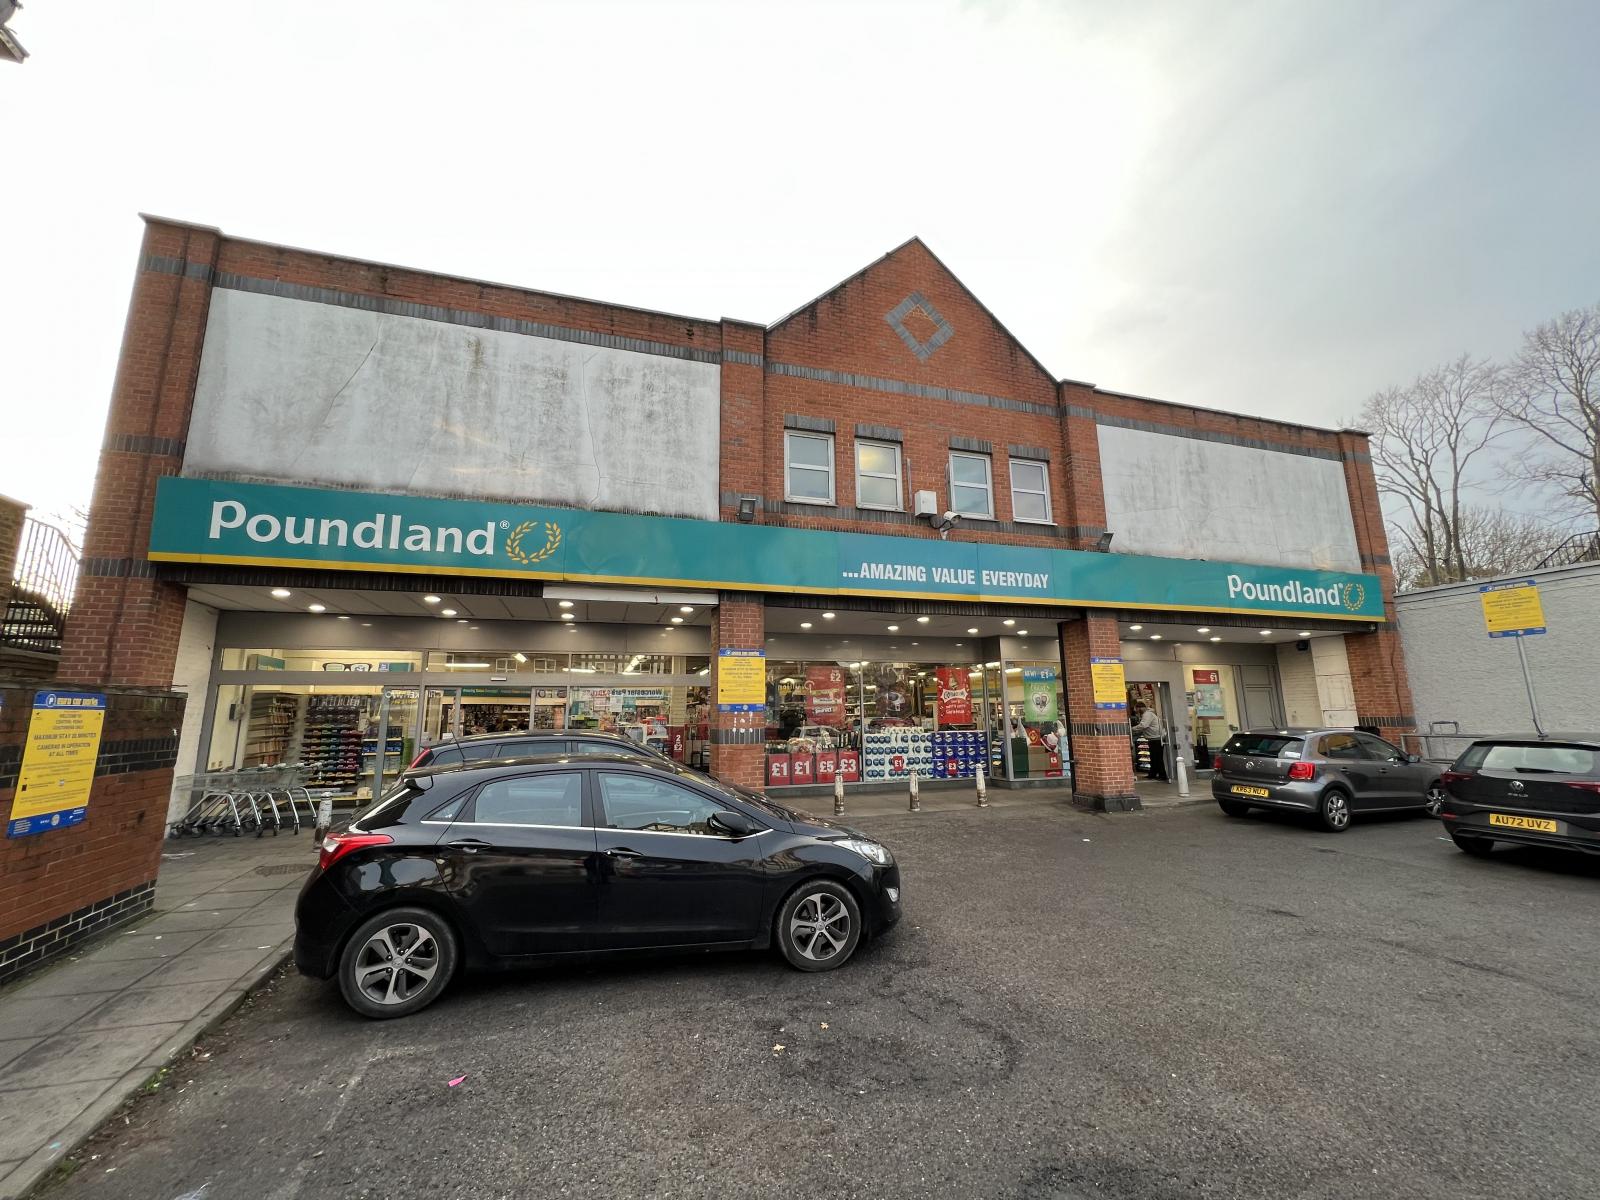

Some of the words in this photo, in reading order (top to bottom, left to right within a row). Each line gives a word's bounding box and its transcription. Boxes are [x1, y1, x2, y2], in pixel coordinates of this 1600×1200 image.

[931, 567, 976, 586] VALUE
[982, 570, 1049, 589] EVERYDAY
[771, 762, 788, 777] £1
[794, 760, 810, 775] £1
[819, 760, 834, 773] £5
[840, 758, 857, 772] £3
[894, 759, 903, 768] £1
[1495, 815, 1523, 827] AU72
[1527, 820, 1551, 830] UVZ
